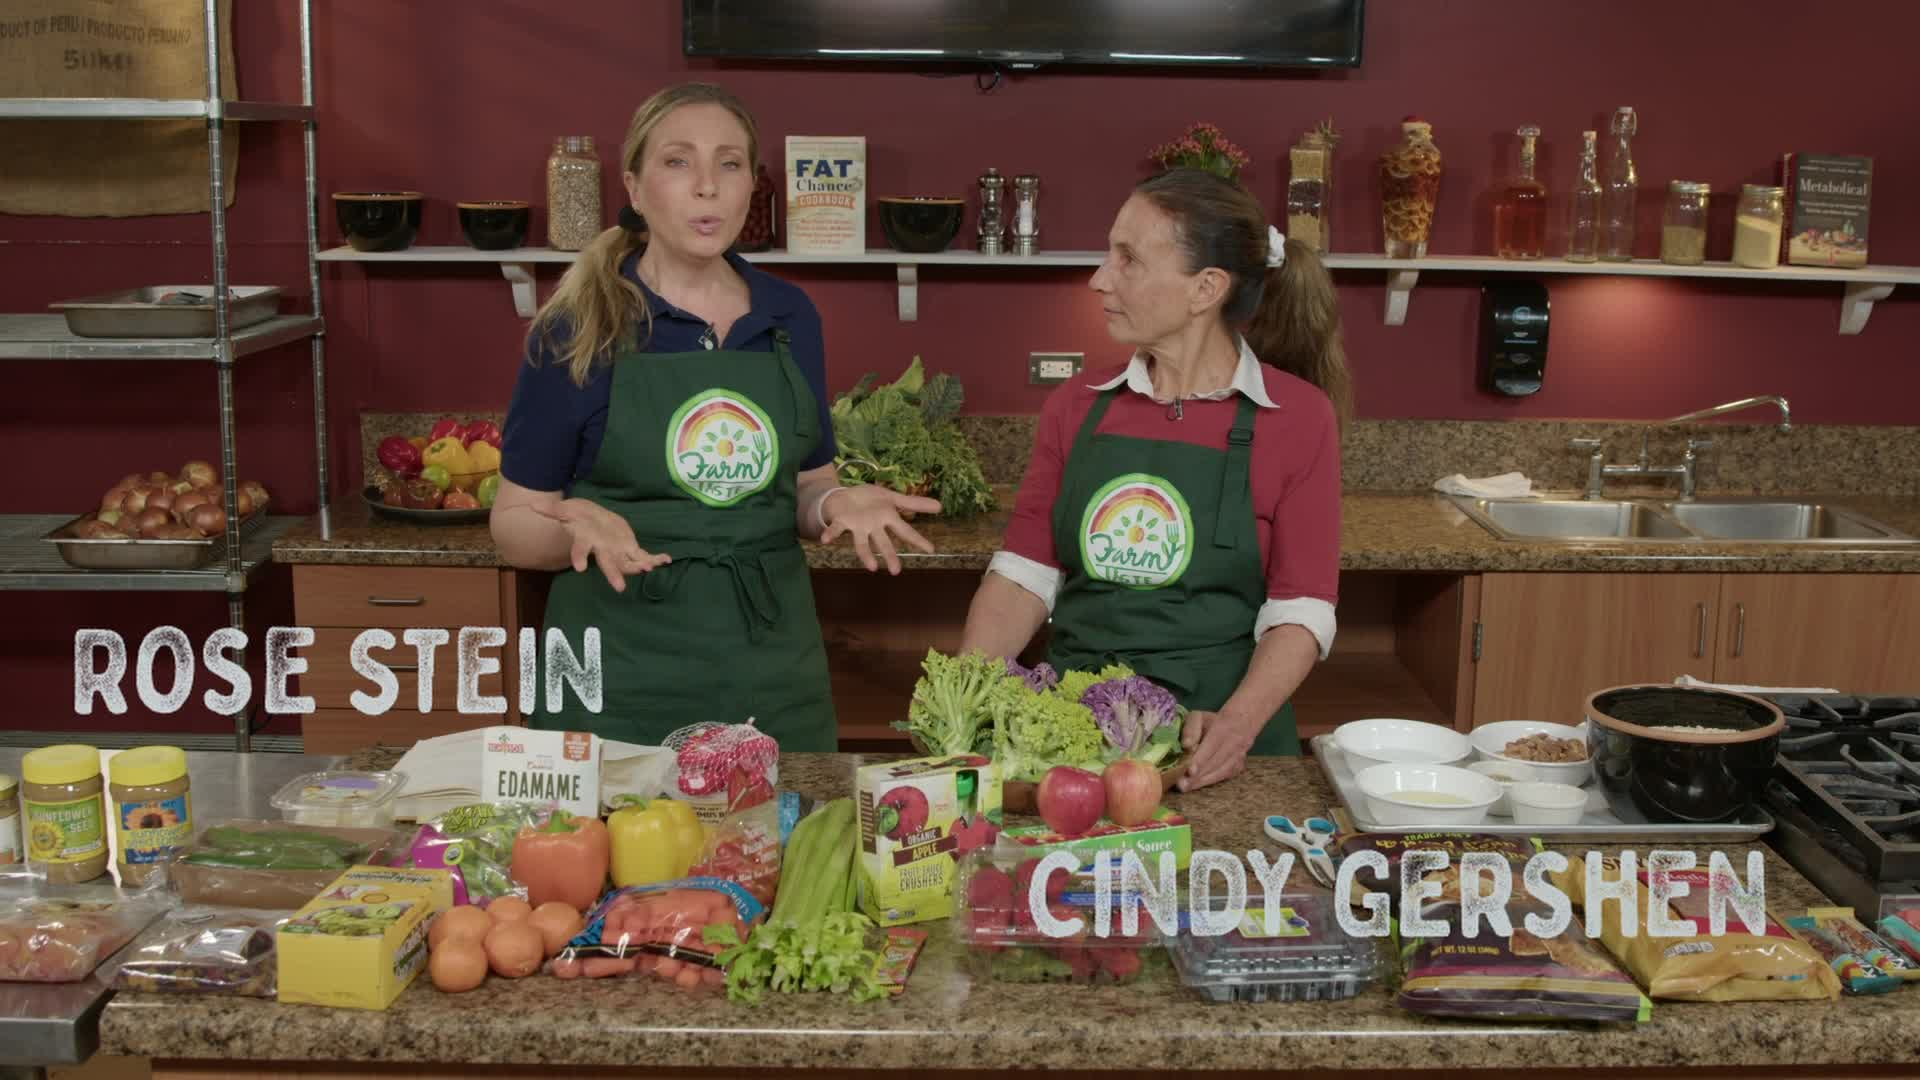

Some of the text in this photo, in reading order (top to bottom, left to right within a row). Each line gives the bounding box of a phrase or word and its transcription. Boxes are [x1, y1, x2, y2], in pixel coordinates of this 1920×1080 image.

[796, 159, 853, 178] FAT
[796, 178, 853, 192] Chance
[1799, 178, 1868, 196] Metabolical
[800, 194, 852, 208] COOKBOOK
[497, 769, 581, 801] EDAMAME
[907, 829, 936, 845] ORGANIC
[912, 843, 937, 860] APPLE
[1136, 839, 1172, 853] Sauce
[900, 873, 944, 892] CRUSHERS
